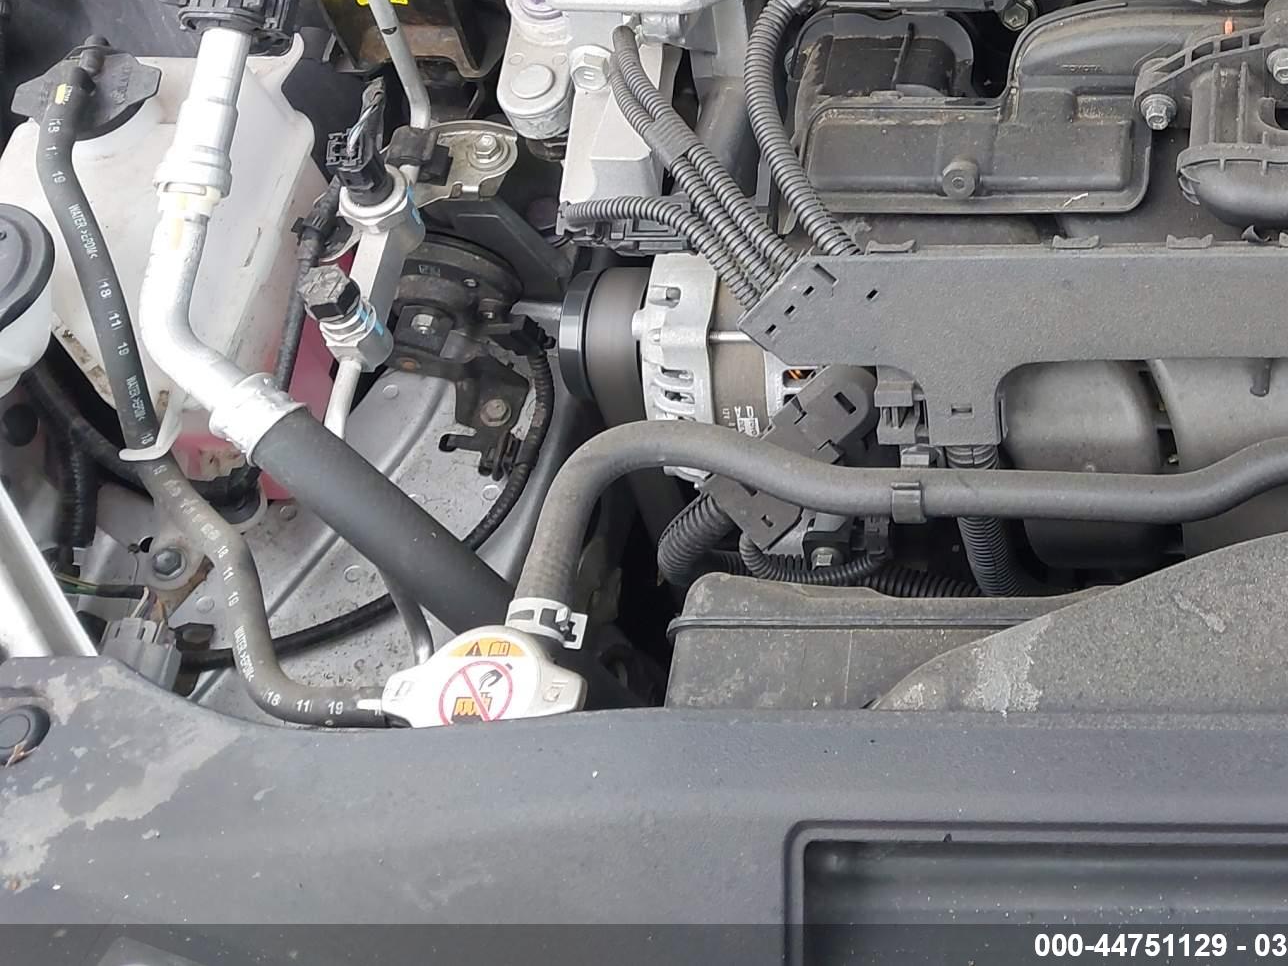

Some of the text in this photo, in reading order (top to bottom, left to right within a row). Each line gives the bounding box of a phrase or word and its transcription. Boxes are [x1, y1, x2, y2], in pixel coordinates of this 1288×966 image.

[68, 203, 87, 229] WATER
[98, 281, 112, 298] 18
[108, 311, 122, 328] 11
[117, 341, 130, 356] 19
[265, 691, 344, 715] 18 11 19
